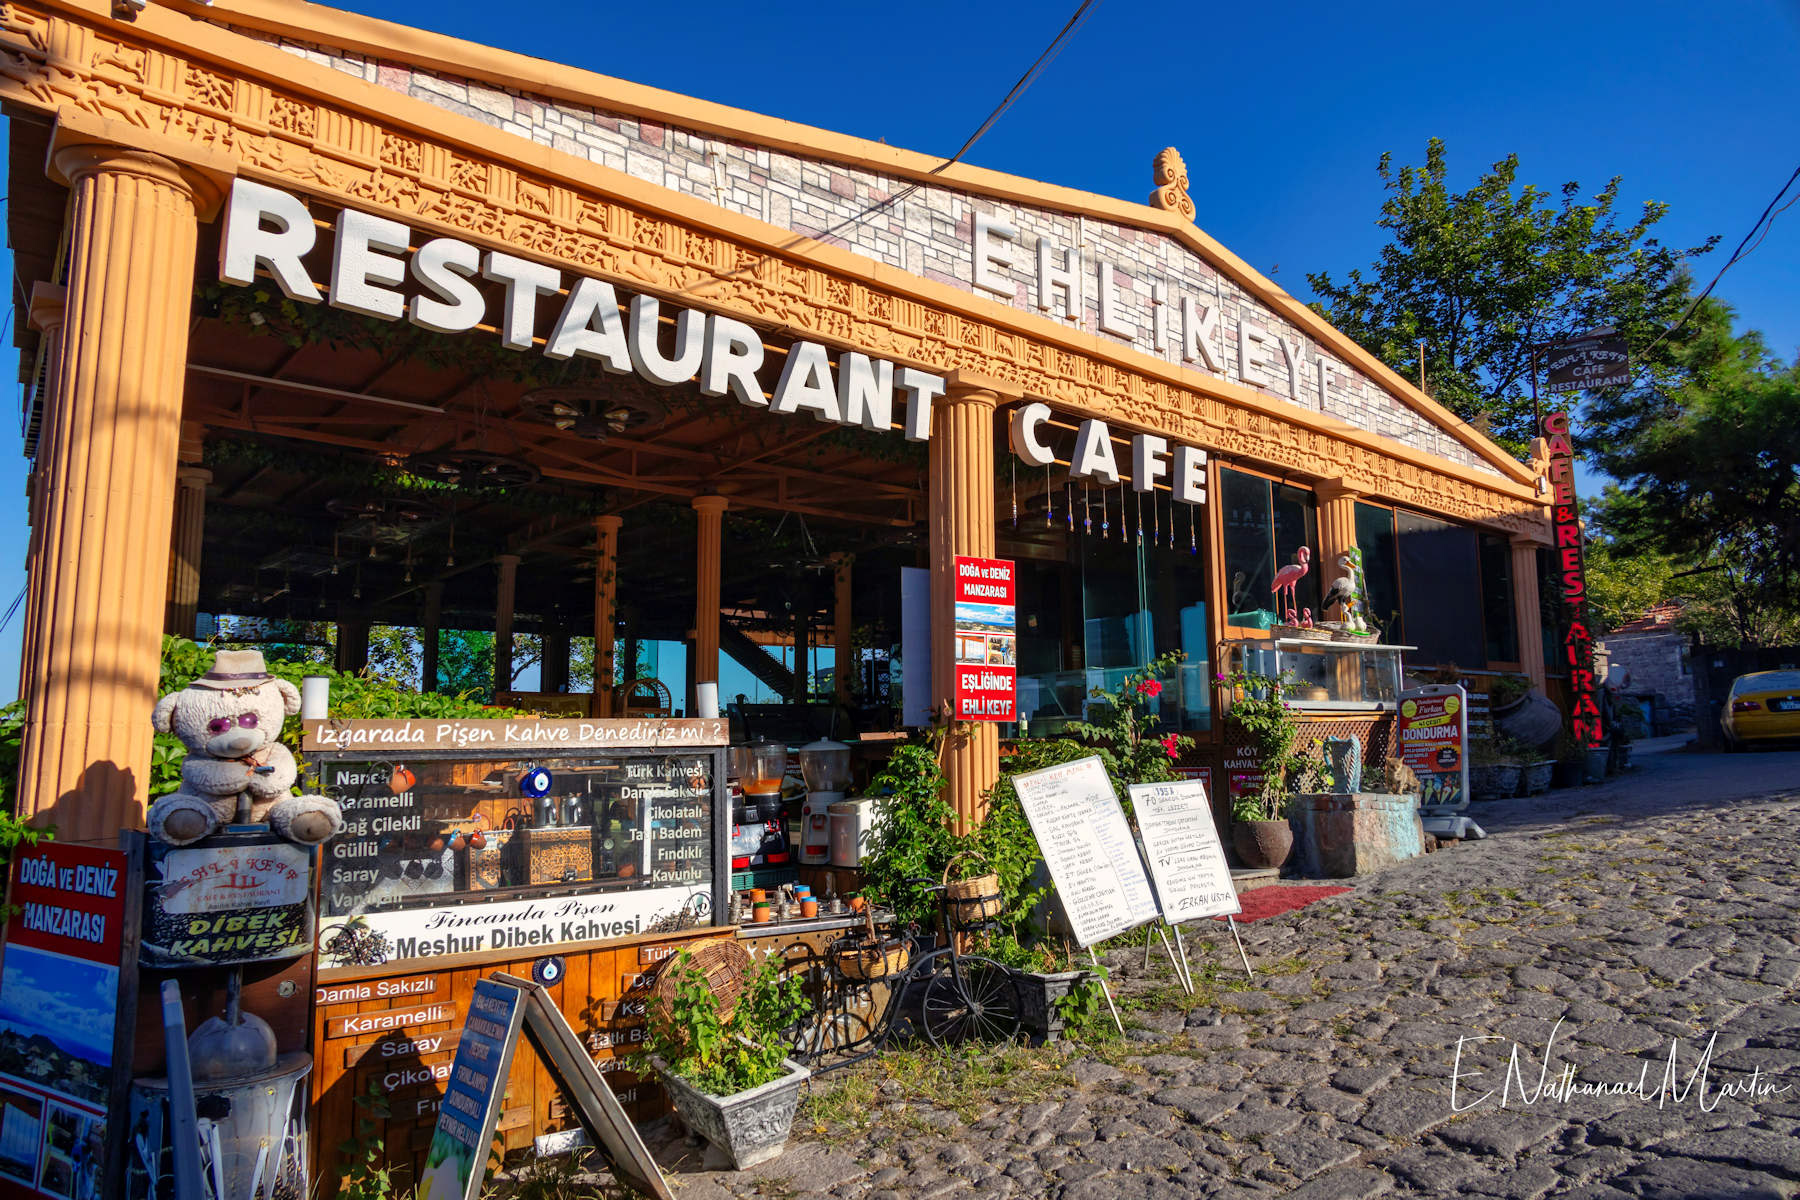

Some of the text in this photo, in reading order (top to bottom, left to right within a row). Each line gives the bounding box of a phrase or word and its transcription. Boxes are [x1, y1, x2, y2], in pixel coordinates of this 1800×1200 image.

[219, 177, 946, 443] RESTAURANT
[1573, 364, 1605, 376] CAFE
[1551, 374, 1629, 392] RESTAURANT
[1012, 402, 1208, 505] CAFE
[1544, 410, 1572, 506] CAFE
[959, 562, 980, 578] DOĞA
[989, 565, 1011, 581] DENİZ
[964, 583, 1007, 598] MANZARASI
[1557, 524, 1603, 748] RESTAURAN
[961, 671, 1013, 693] EŞLİĞİNDE
[962, 695, 1012, 715] EHLİ KEYF
[316, 722, 425, 748] Izgarada
[436, 722, 495, 747] Pişen
[504, 721, 570, 741] Kahve
[578, 721, 676, 741] Denediniz
[1402, 725, 1458, 741] DONDURMA
[1236, 746, 1259, 757] KÖY
[625, 763, 703, 778] Türk Kahvesi
[338, 792, 414, 811] Karamelli
[336, 816, 421, 837] Dağ Çilekli
[629, 826, 702, 841] Taı Badem
[333, 842, 378, 858] Güllü
[657, 846, 702, 861] Fındıklı
[1158, 857, 1171, 867] TV
[75, 861, 118, 898] DENİZ
[332, 868, 379, 884] Saray
[652, 866, 702, 882] Kavunlu
[1178, 892, 1232, 911] ERKAN USTA
[23, 901, 106, 944] MANZARASI
[188, 912, 289, 935] DİBEK
[425, 899, 619, 929] Fincanda Pişen
[169, 925, 300, 956] KAHVESİ
[396, 914, 641, 960] Meshur Dibek Kahvesi
[316, 977, 434, 1003] Damla Sakızlı
[344, 1006, 442, 1033] Karamelli
[381, 1037, 443, 1057] Saray
[593, 1031, 625, 1047] Tatlı
